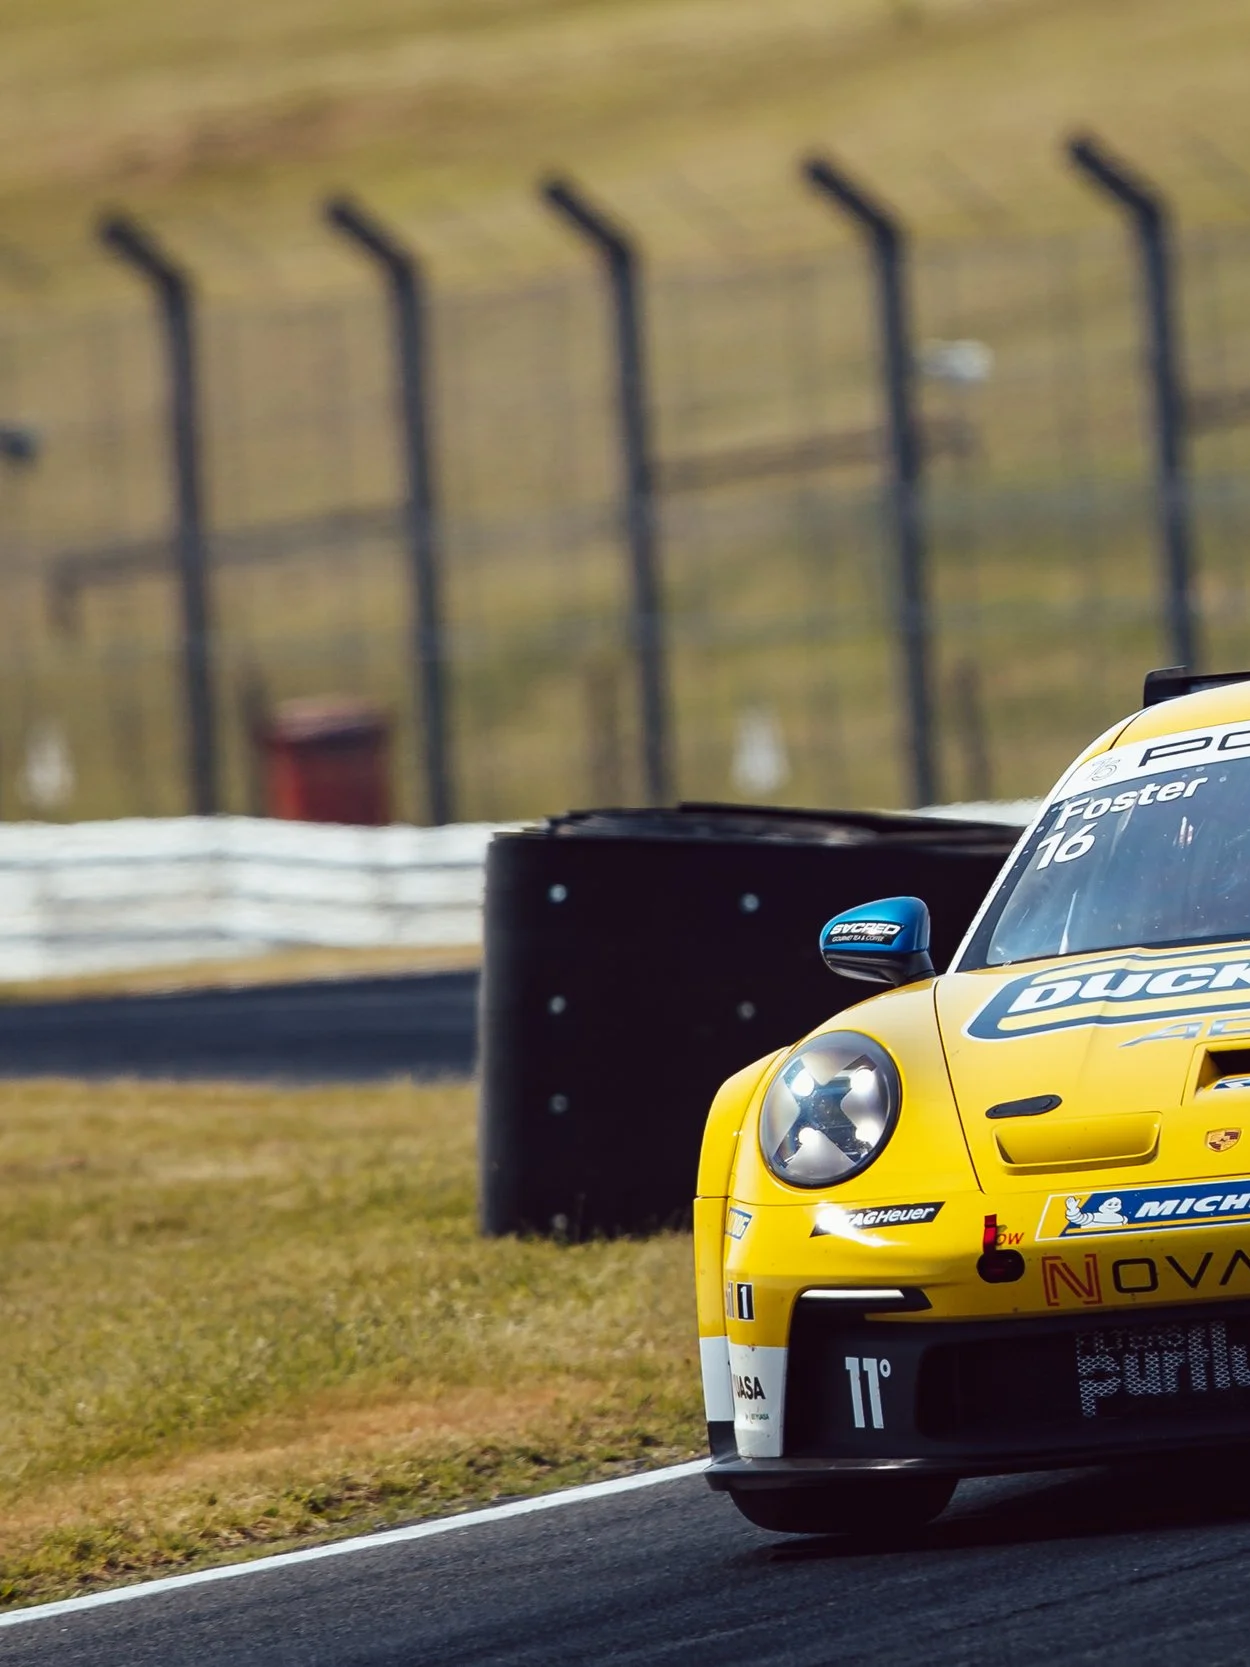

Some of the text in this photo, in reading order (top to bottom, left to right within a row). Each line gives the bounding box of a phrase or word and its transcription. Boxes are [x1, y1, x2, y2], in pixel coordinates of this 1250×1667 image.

[1055, 777, 1208, 831] Foster
[1035, 823, 1097, 871] 16
[733, 1374, 766, 1400] UASA
